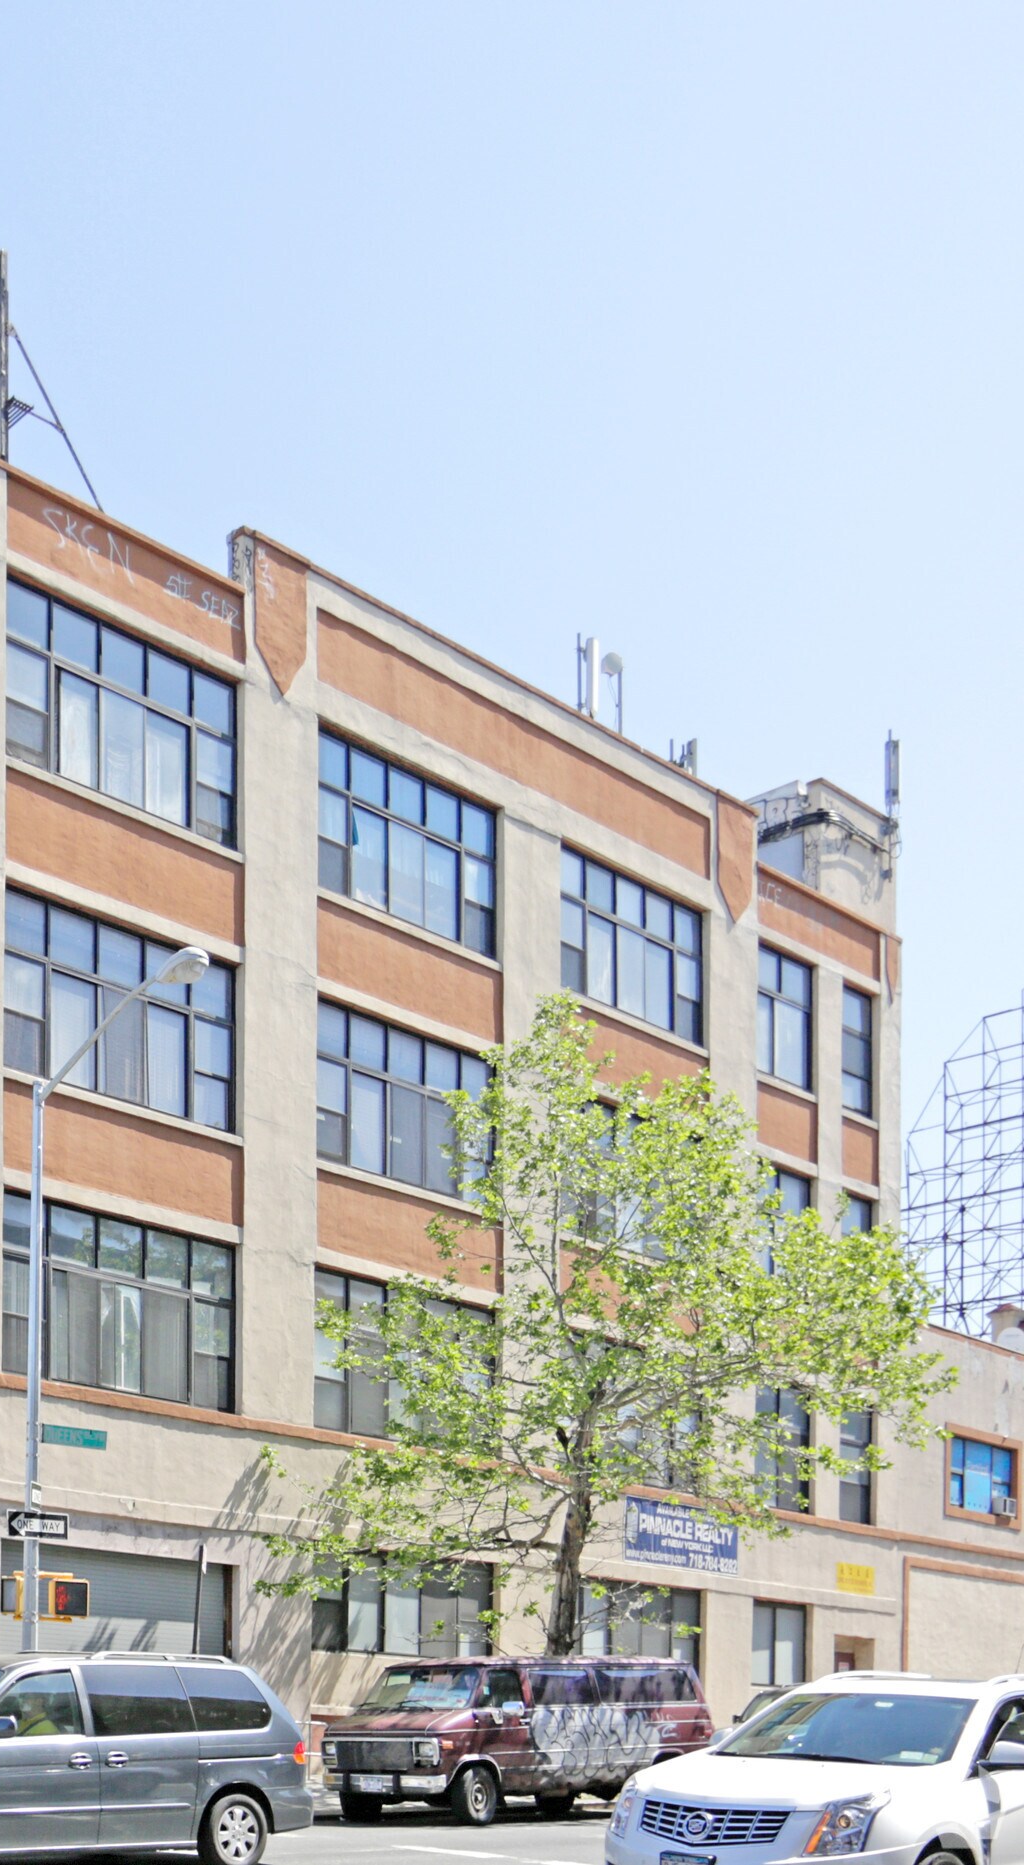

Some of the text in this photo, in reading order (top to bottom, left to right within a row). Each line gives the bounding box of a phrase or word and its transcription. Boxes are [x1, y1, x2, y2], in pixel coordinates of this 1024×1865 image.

[17, 1519, 60, 1532] ONE WAY
[639, 1513, 693, 1540] PINNACLE
[695, 1522, 733, 1546] REALTY
